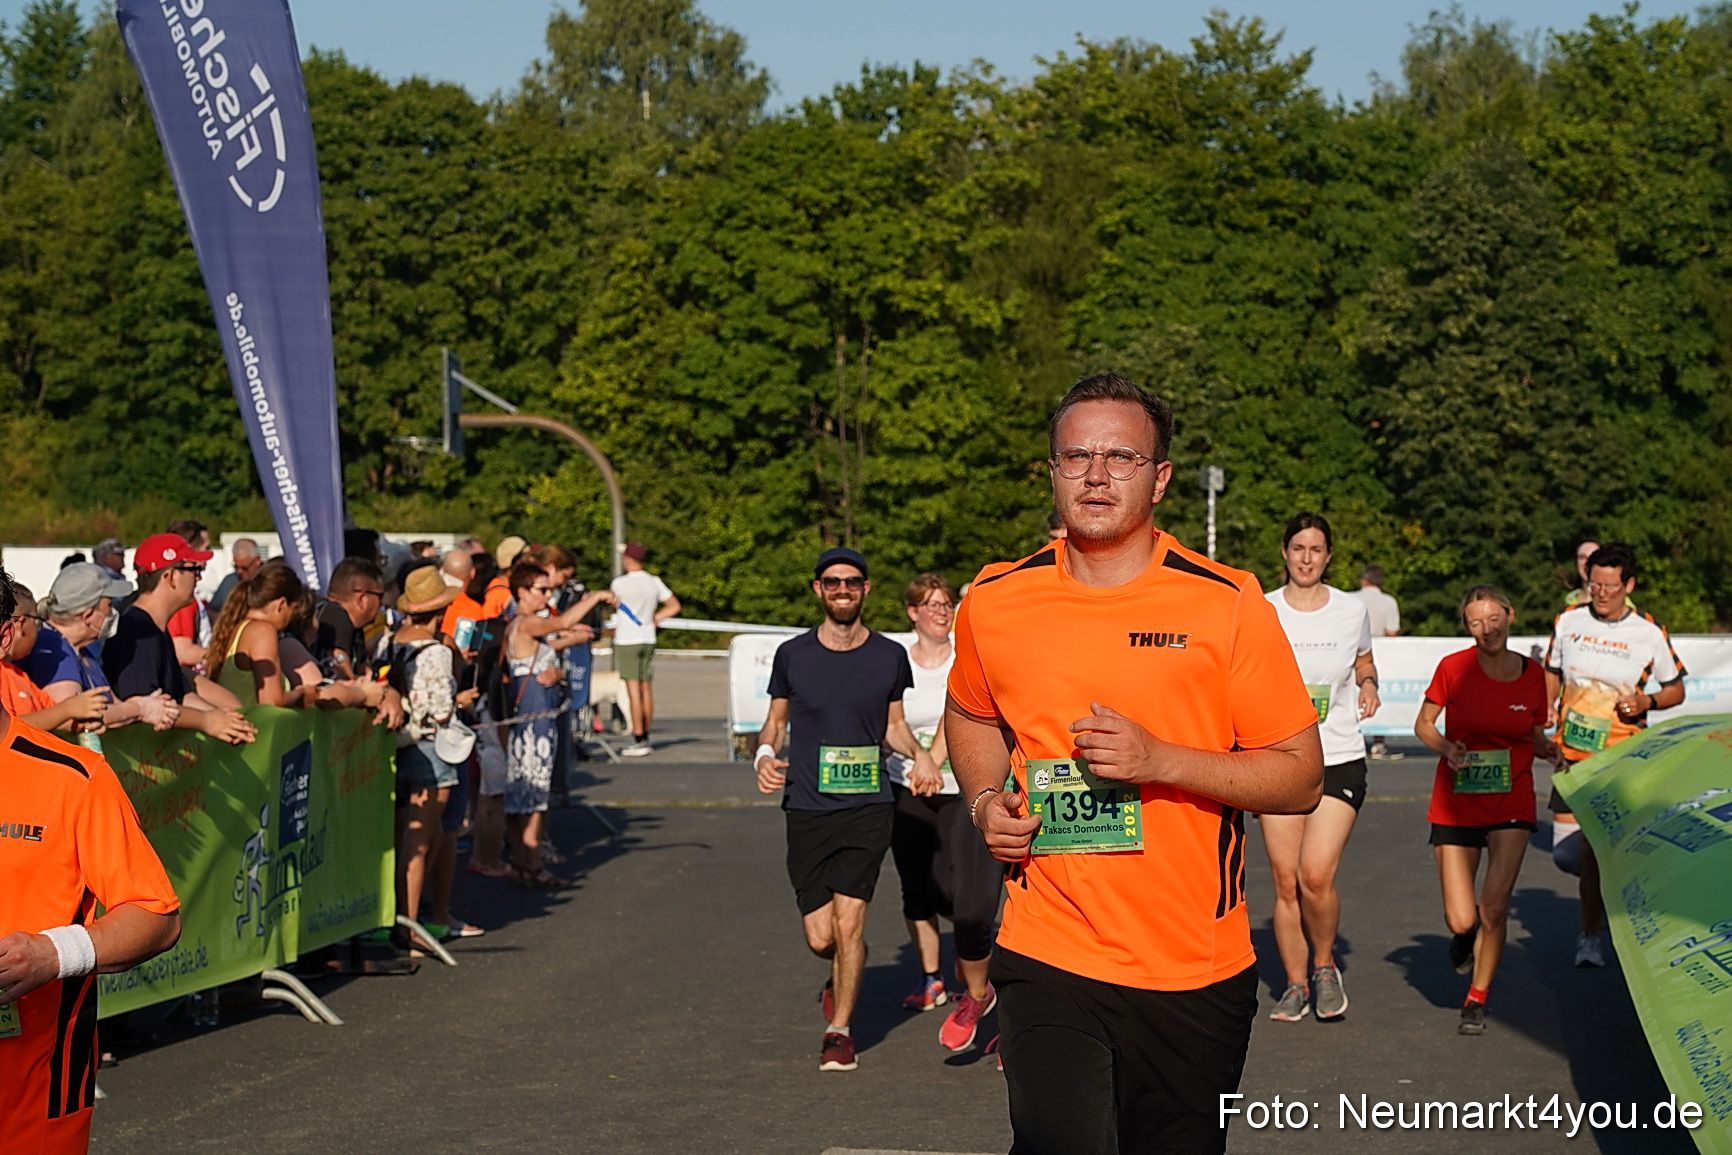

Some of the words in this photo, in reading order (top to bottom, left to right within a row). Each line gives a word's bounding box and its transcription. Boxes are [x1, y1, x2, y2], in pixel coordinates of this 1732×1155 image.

[1128, 632, 1187, 649] THULE
[1570, 724, 1596, 741] 834
[830, 763, 871, 778] 1085
[1464, 765, 1501, 780] 1720
[1045, 788, 1121, 822] 1394
[1123, 793, 1137, 837] 2022
[0, 822, 44, 842] HULE
[1043, 825, 1072, 835] Takacs
[1074, 823, 1125, 834] Domonkos
